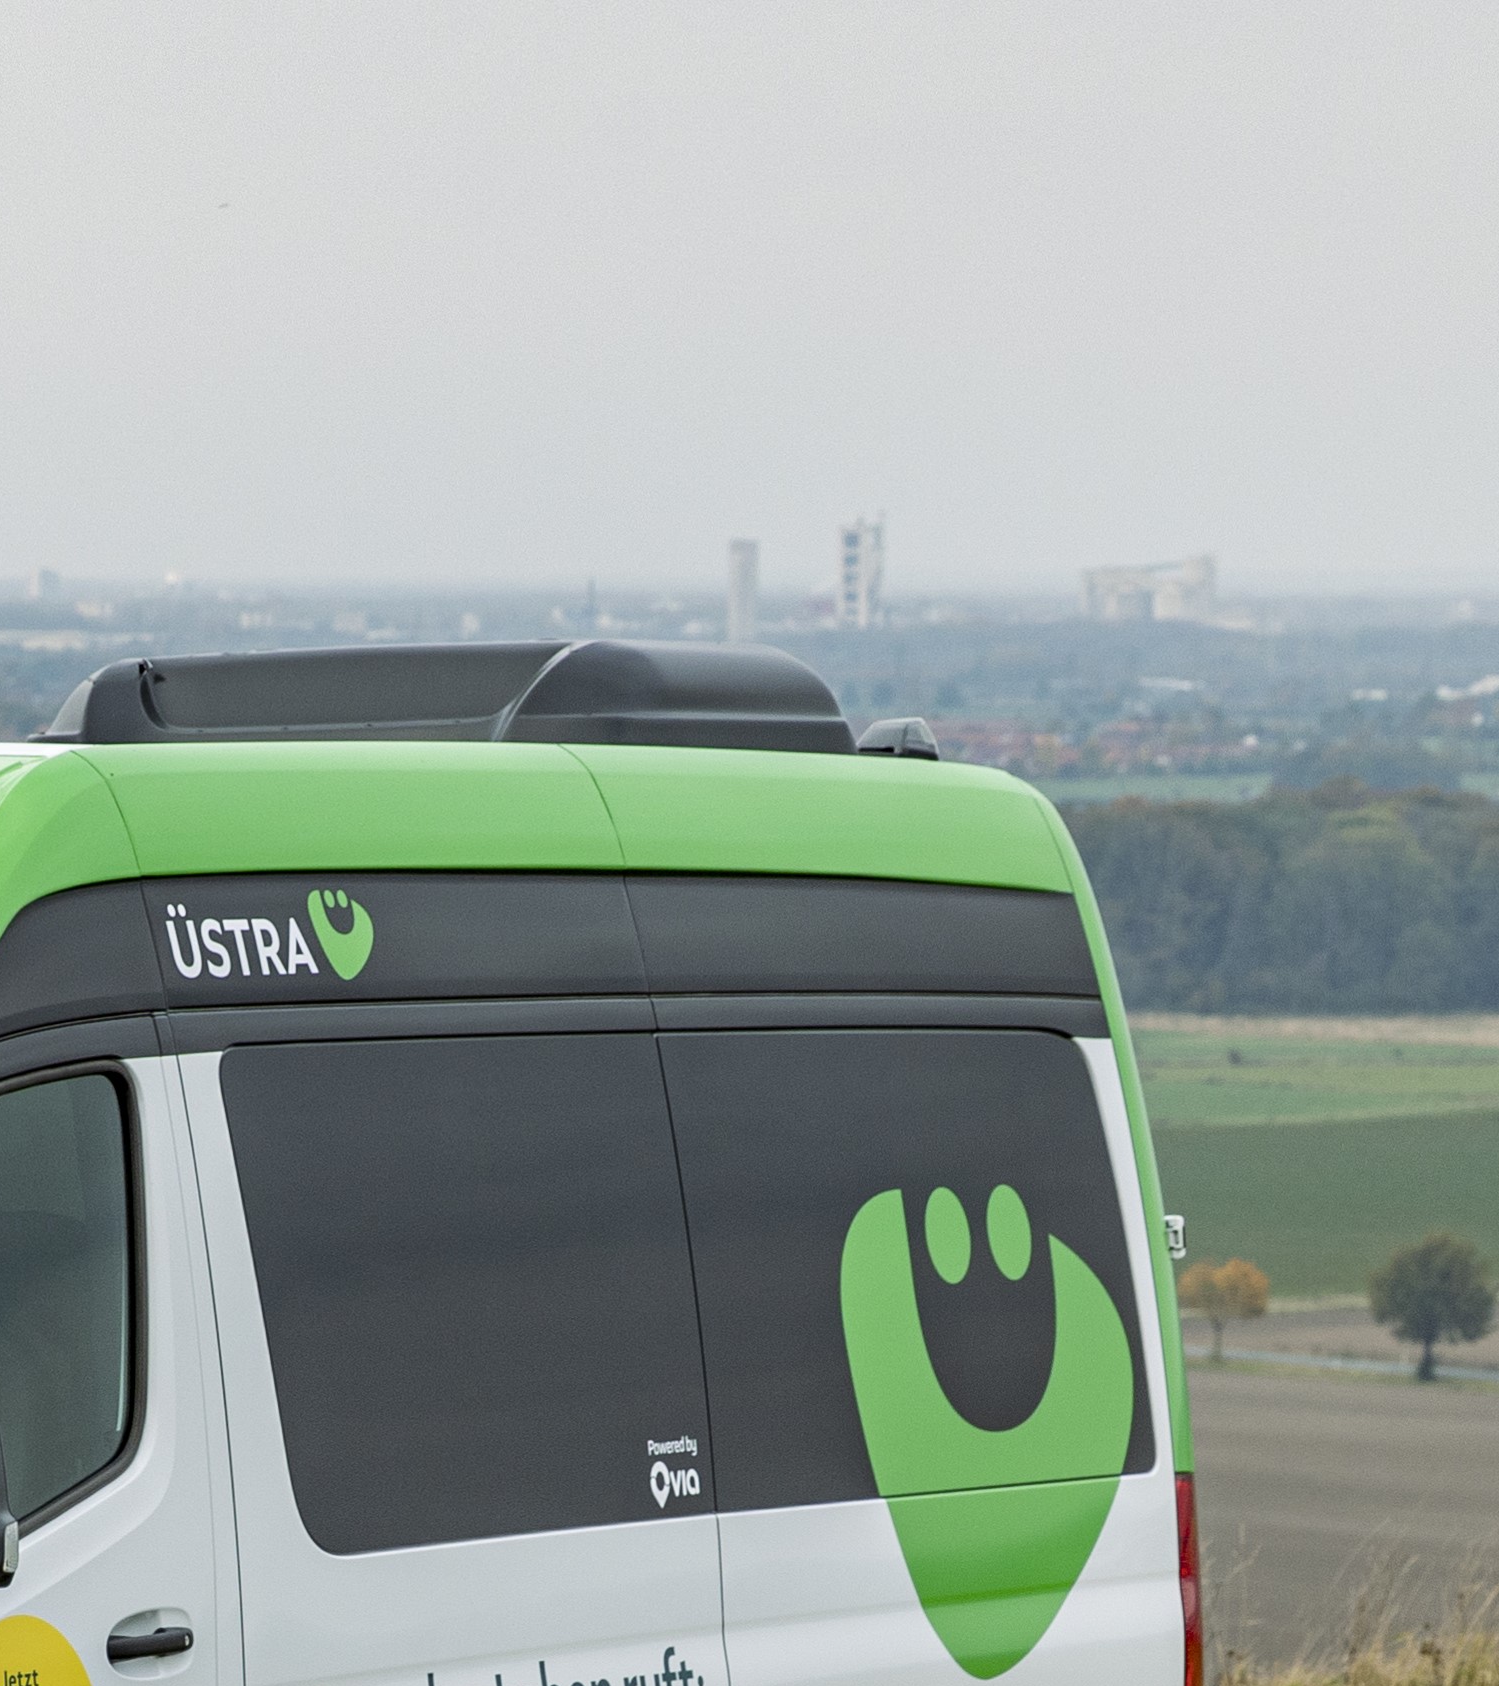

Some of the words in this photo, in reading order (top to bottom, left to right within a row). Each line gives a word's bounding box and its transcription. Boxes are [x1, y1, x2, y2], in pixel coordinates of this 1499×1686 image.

[165, 903, 320, 979] ÜSTRA
[647, 1436, 685, 1456] Powered
[685, 1435, 698, 1456] by
